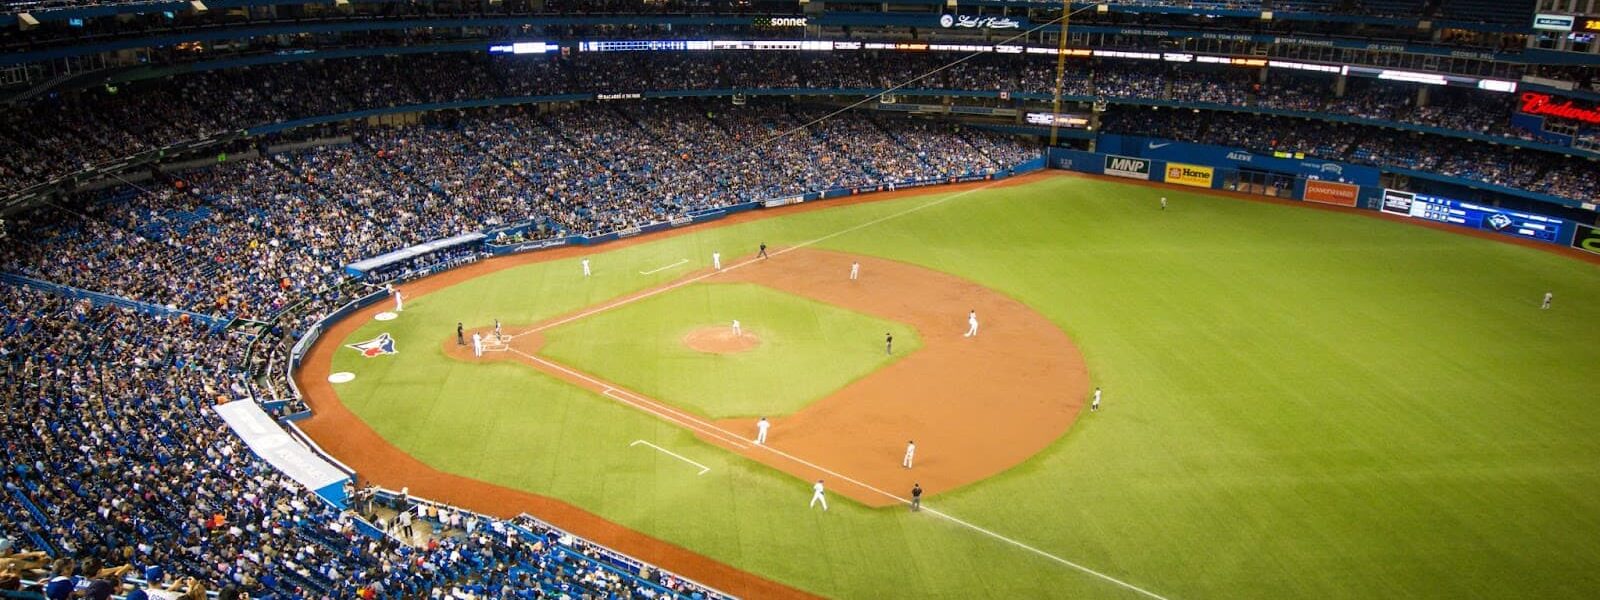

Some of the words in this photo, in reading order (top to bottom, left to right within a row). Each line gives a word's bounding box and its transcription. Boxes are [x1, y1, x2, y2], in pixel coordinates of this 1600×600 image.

[771, 17, 808, 26] sonnet
[1111, 158, 1145, 172] MNP
[1183, 168, 1210, 178] Home
